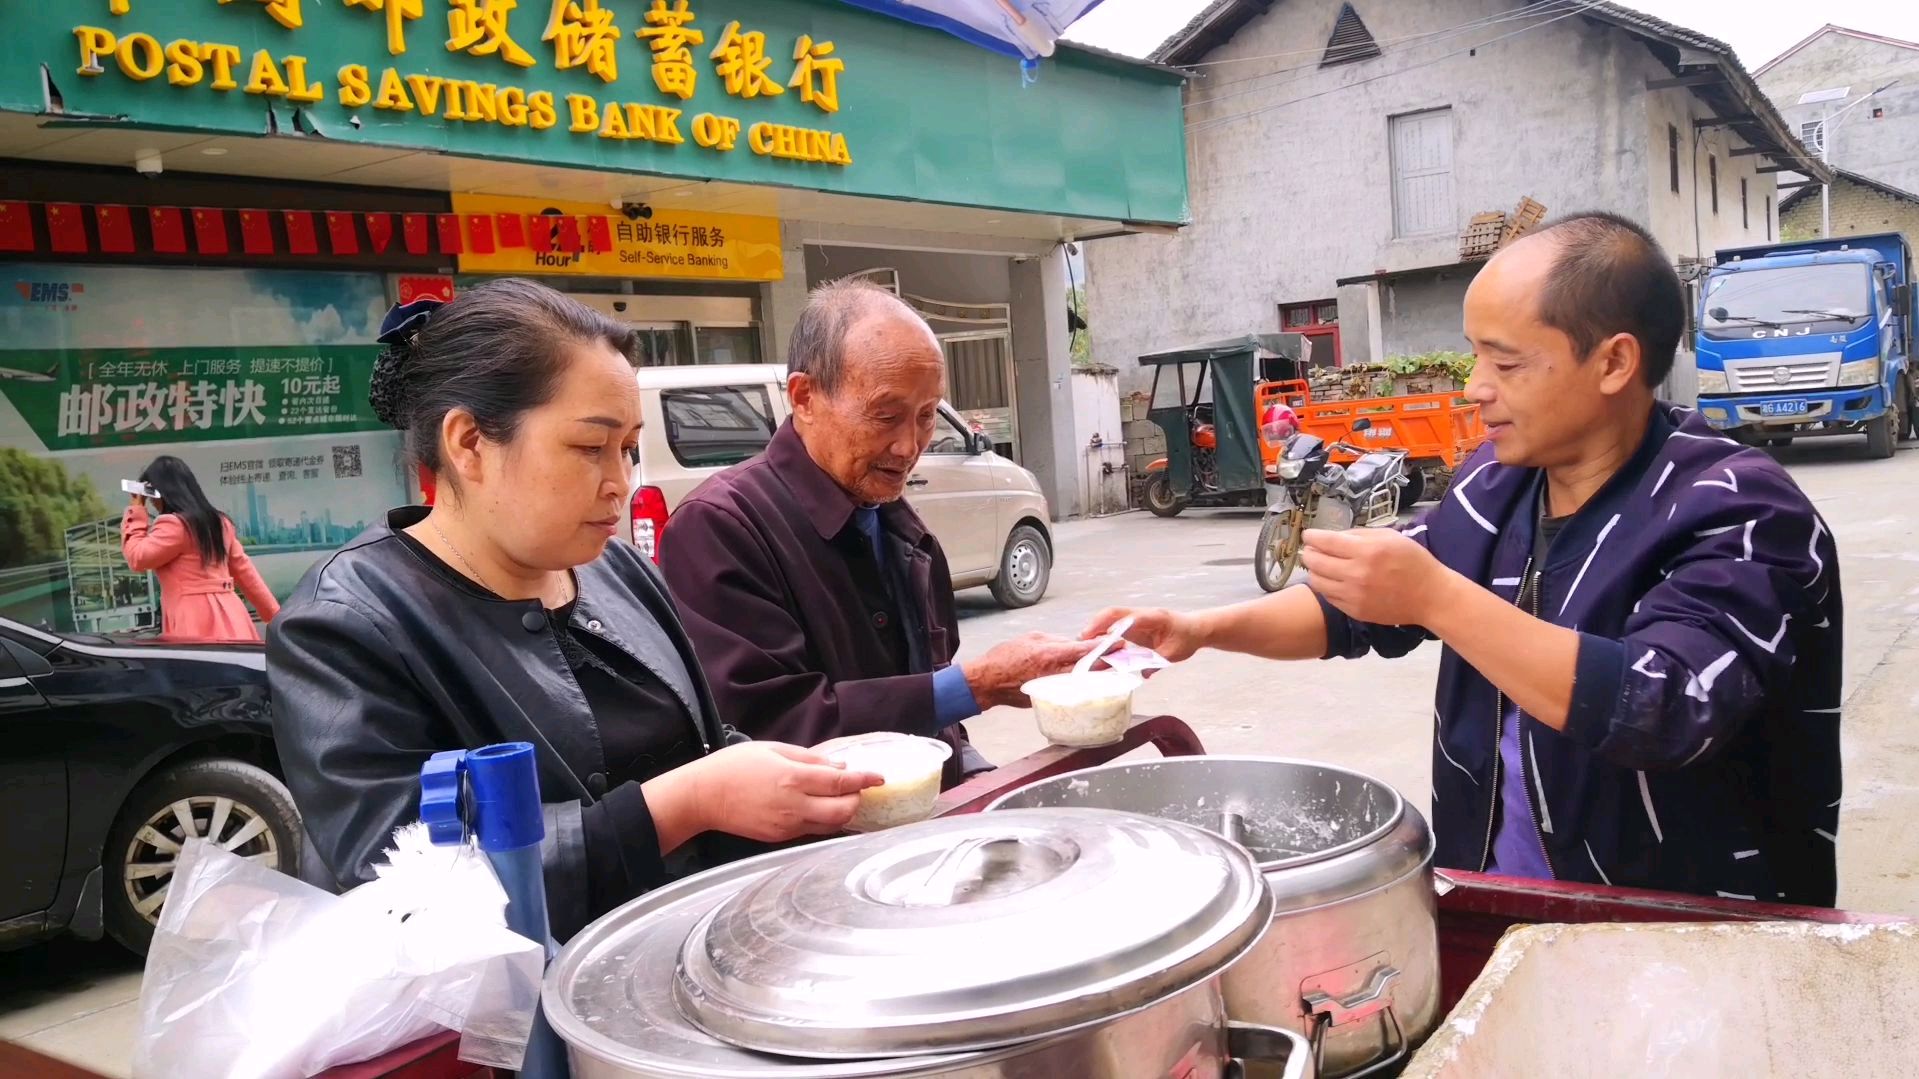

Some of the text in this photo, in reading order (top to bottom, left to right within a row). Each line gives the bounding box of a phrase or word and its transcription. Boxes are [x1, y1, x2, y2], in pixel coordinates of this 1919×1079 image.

[108, 0, 844, 113] 政储蓄银行
[72, 24, 852, 165] POSTAL SAVINGS BANK OF CHINA
[616, 220, 725, 248] 自助银行服务
[535, 252, 572, 267] Hour
[619, 250, 729, 269] Self-Service Banking
[30, 282, 69, 302] EMS
[1752, 327, 1811, 339] CNJ
[177, 358, 242, 375] 上门服务
[281, 374, 341, 395] 10元起
[57, 378, 267, 438] 邮政特快
